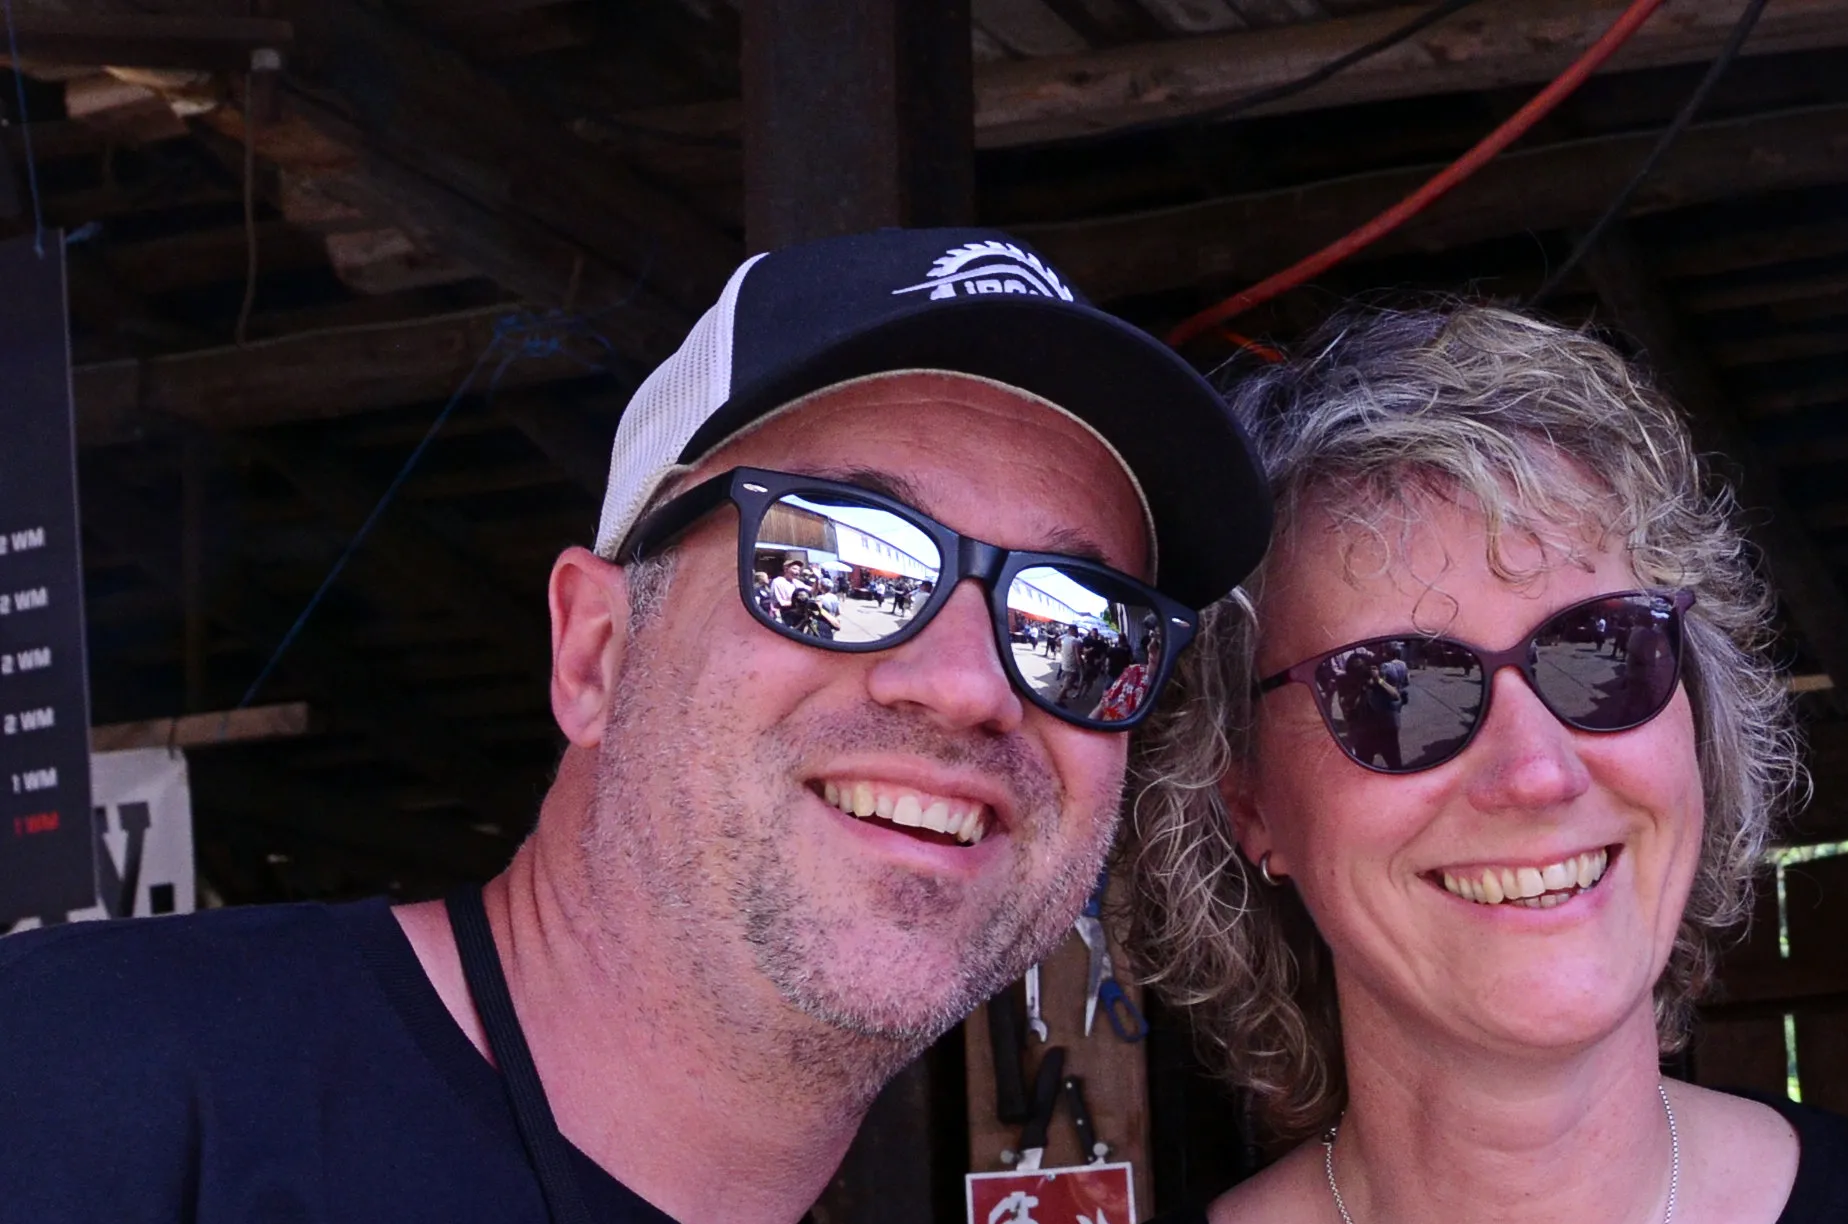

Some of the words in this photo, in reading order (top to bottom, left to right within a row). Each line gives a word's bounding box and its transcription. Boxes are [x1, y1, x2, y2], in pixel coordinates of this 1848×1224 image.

[11, 525, 46, 551] WM
[14, 585, 49, 612] WM
[1, 653, 14, 675] 2
[17, 646, 52, 671] WM
[4, 712, 17, 735] 2
[20, 706, 55, 731] WM
[12, 773, 21, 794] 1
[23, 766, 58, 792] WM
[26, 811, 60, 834] WM
